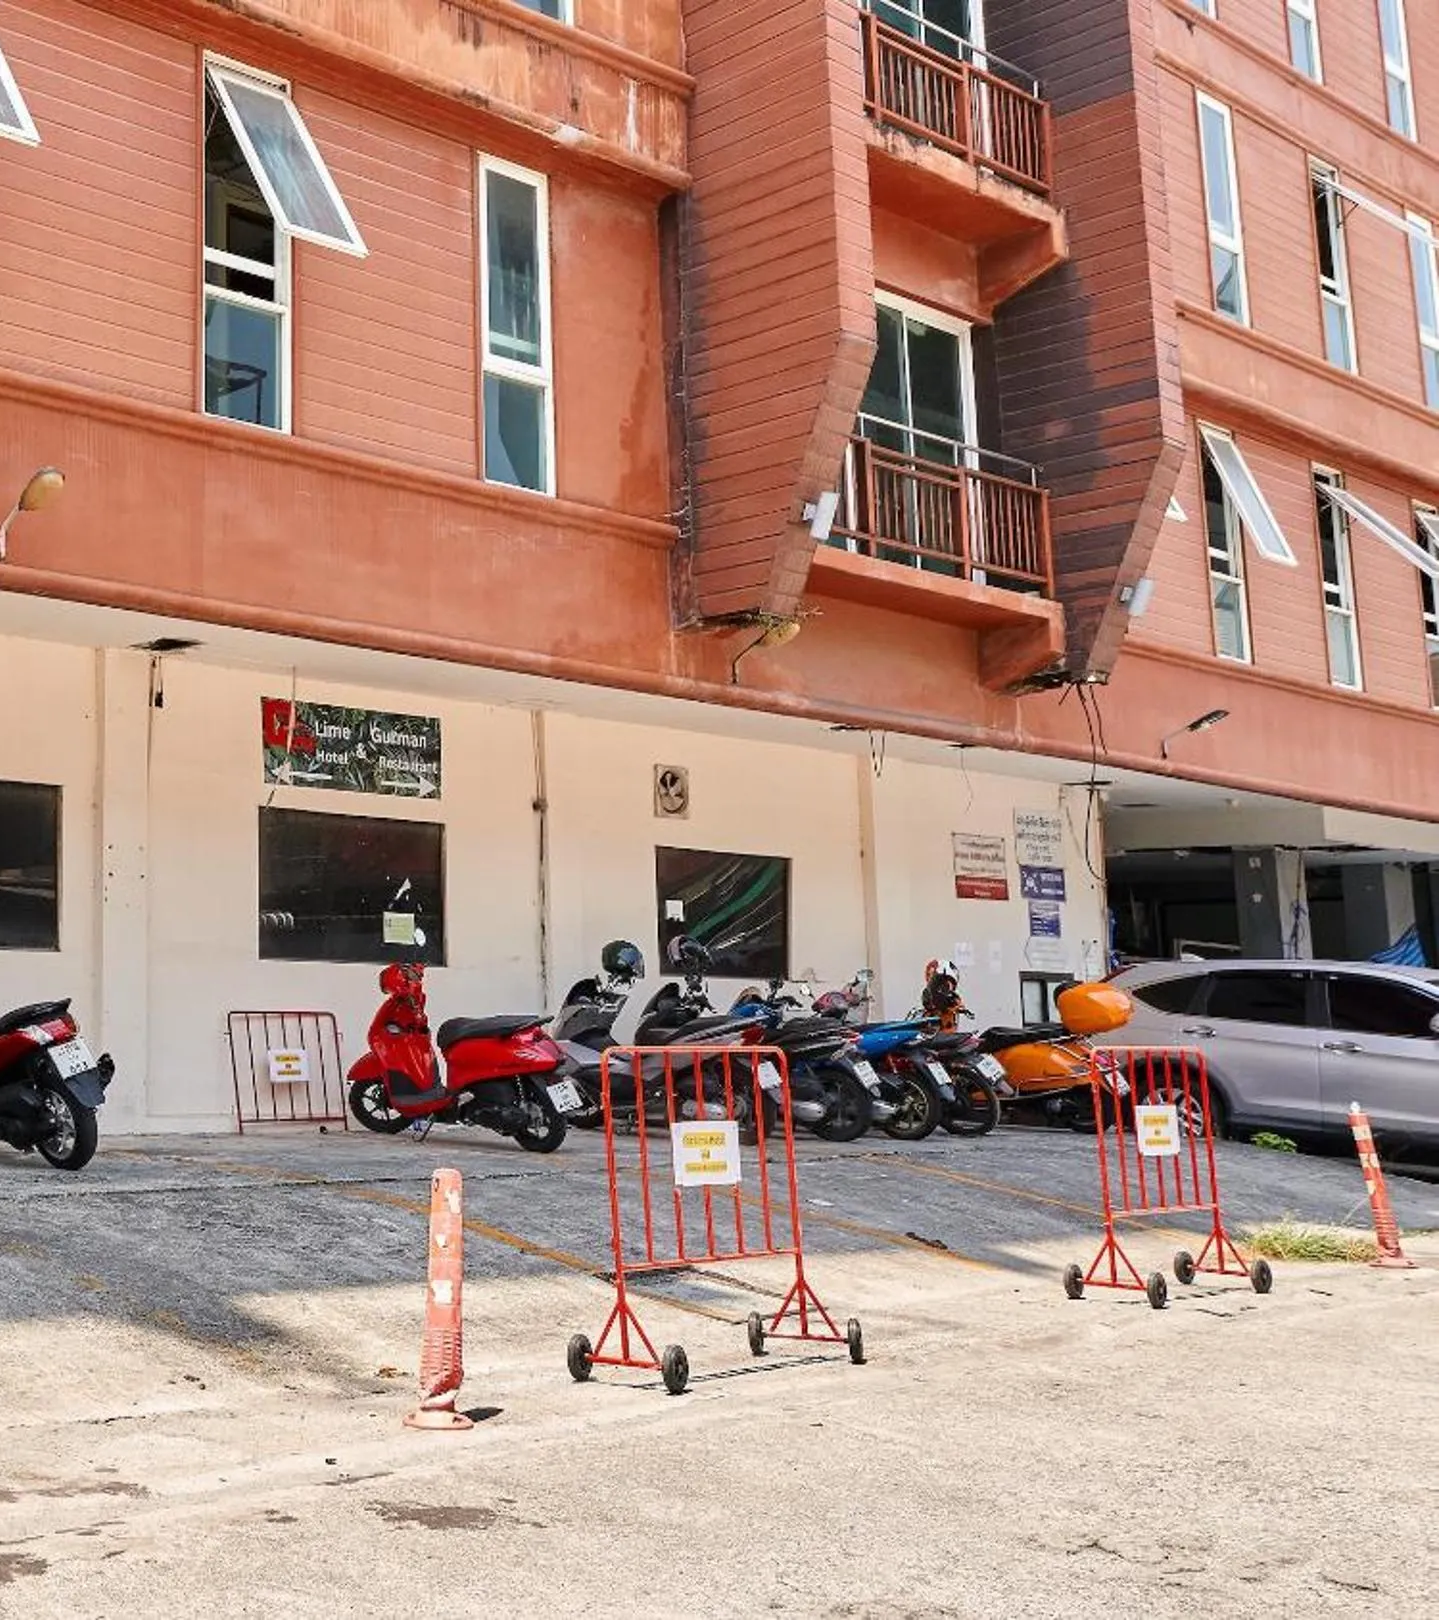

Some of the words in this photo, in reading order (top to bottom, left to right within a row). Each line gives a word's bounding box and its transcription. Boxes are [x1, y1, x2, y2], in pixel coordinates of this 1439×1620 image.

[315, 720, 350, 740] Lime
[316, 749, 348, 765] Hotel
[356, 742, 367, 759] &
